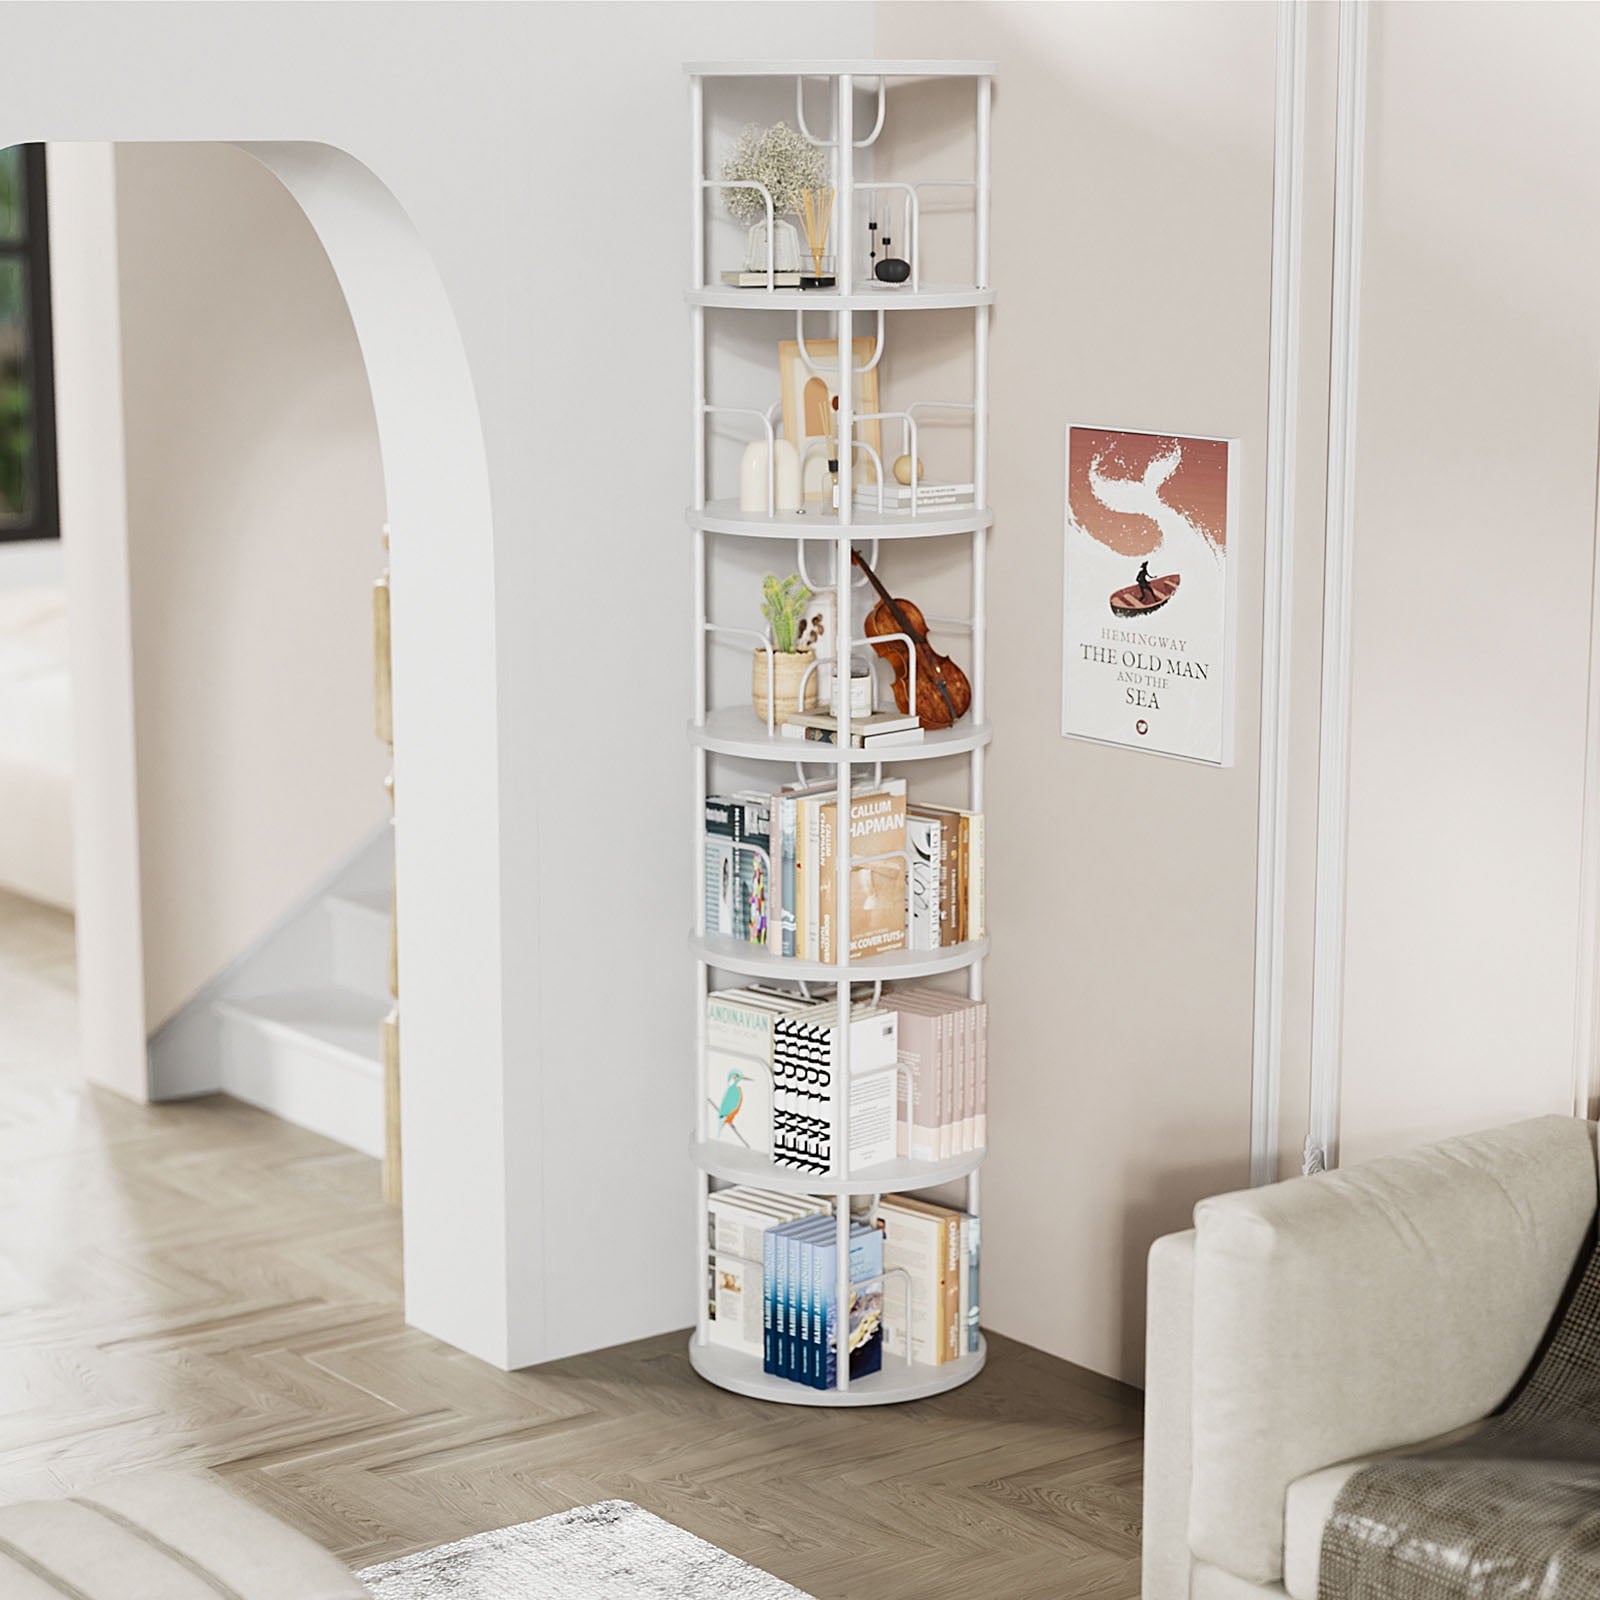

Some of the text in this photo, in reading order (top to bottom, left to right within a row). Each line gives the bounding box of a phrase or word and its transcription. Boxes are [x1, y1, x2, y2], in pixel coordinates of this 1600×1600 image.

[1101, 627, 1187, 652] HEMINGWAY
[1080, 643, 1209, 680] THE OLD MAN
[1117, 671, 1169, 689] AND THE
[1125, 687, 1160, 710] SEA
[851, 800, 891, 818] CALLUM
[850, 813, 904, 837] HAPMAN
[858, 935, 882, 949] COVER
[708, 1004, 769, 1032] ANDINAVIAN
